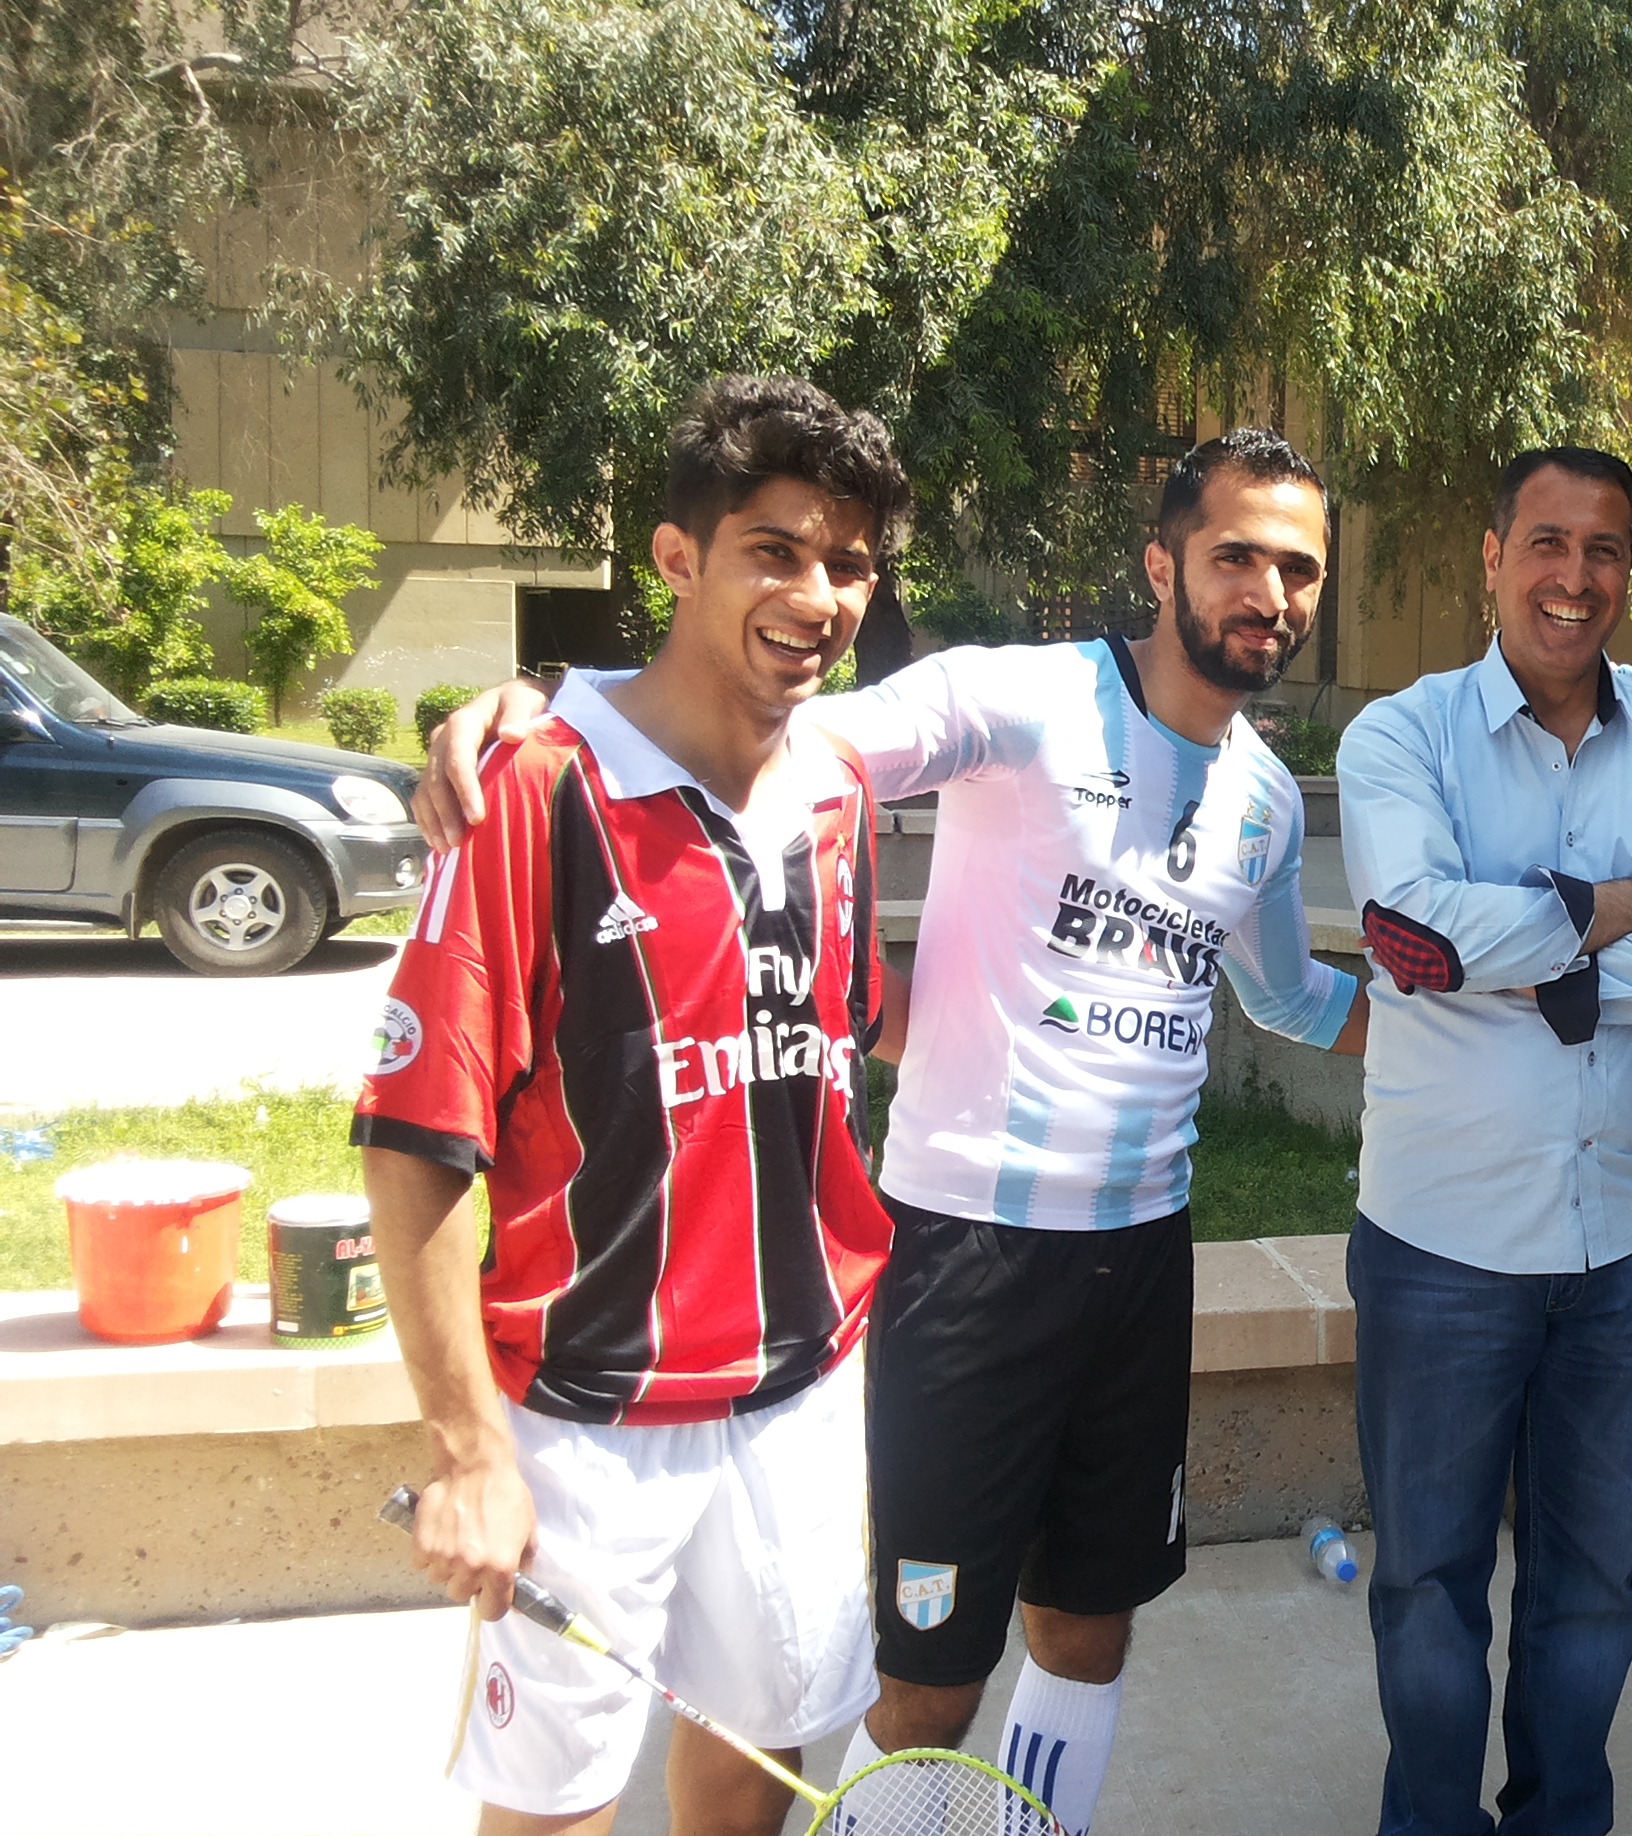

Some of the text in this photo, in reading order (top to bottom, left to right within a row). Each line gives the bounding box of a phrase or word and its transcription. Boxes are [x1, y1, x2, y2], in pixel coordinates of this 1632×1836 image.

[1073, 787, 1133, 811] Topper
[1166, 799, 1201, 883] 6
[596, 916, 659, 944] adidas
[748, 945, 812, 1007] Fly
[383, 1004, 417, 1036] CALCIO
[901, 1578, 950, 1599] C.A.T.
